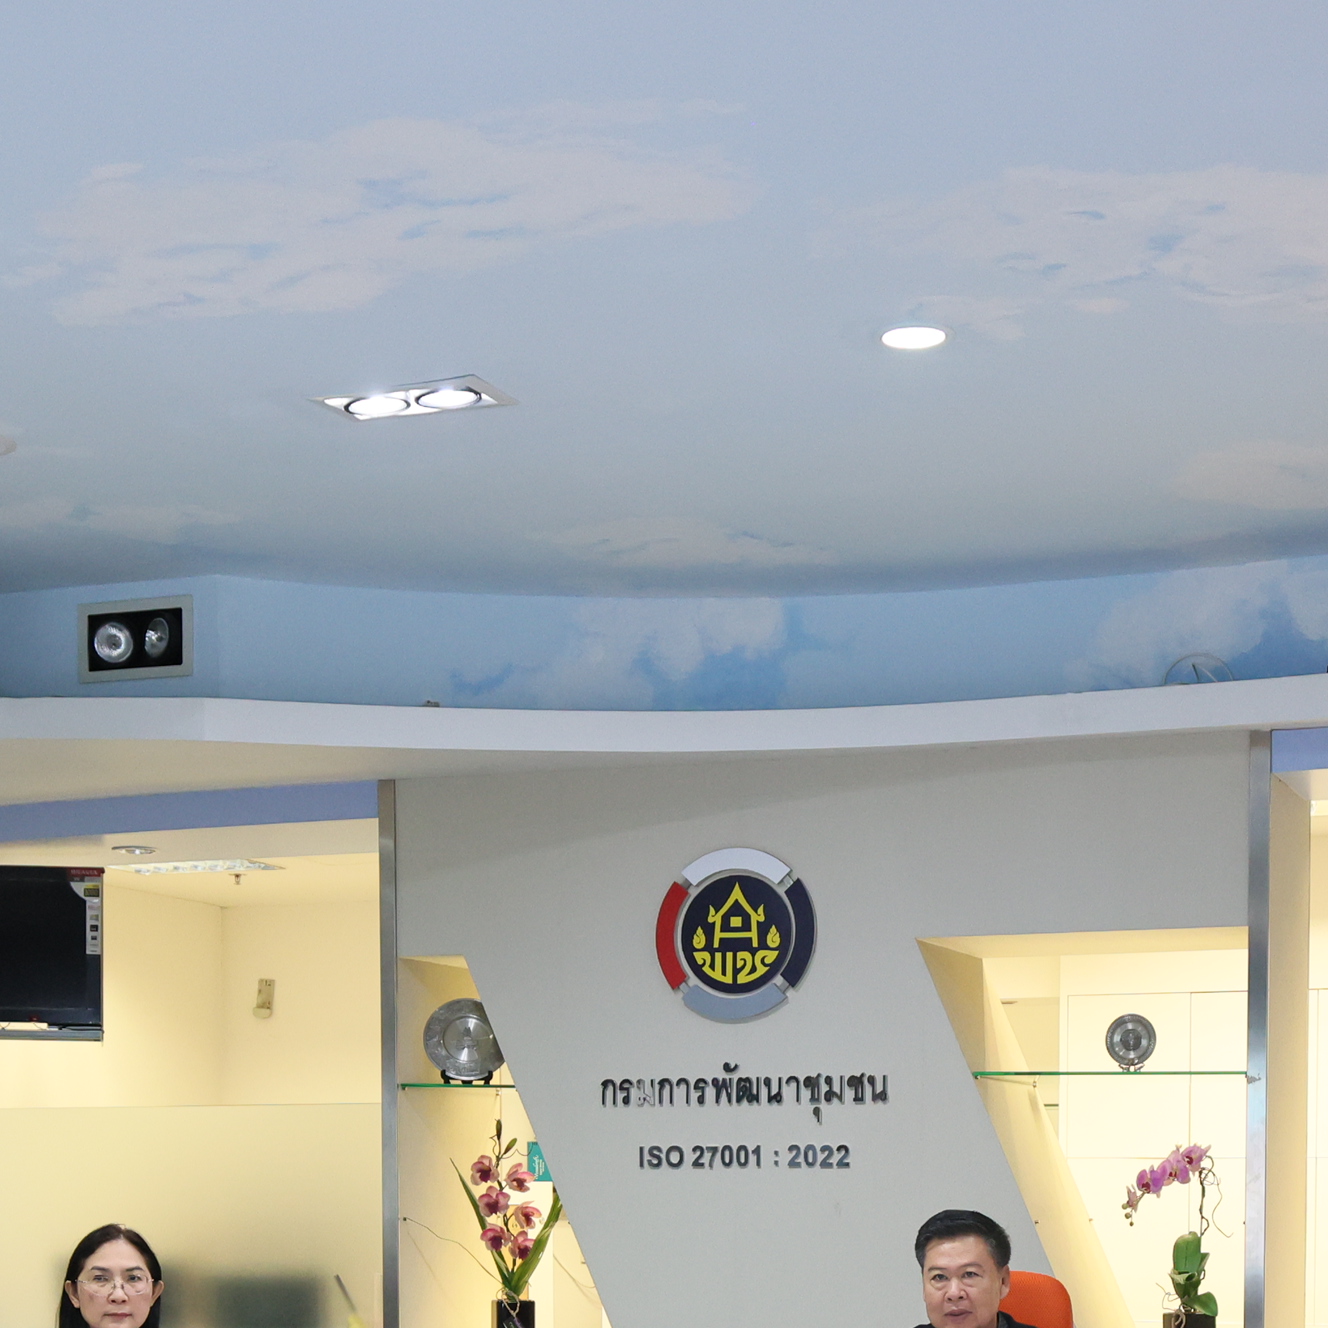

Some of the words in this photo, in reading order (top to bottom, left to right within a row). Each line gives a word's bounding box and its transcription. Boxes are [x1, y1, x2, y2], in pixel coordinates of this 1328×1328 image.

[600, 1061, 890, 1125] กรมการพัฒนาชุมชน
[638, 1145, 685, 1169] ISO
[691, 1144, 763, 1169] 27001
[787, 1144, 852, 1169] 2022
